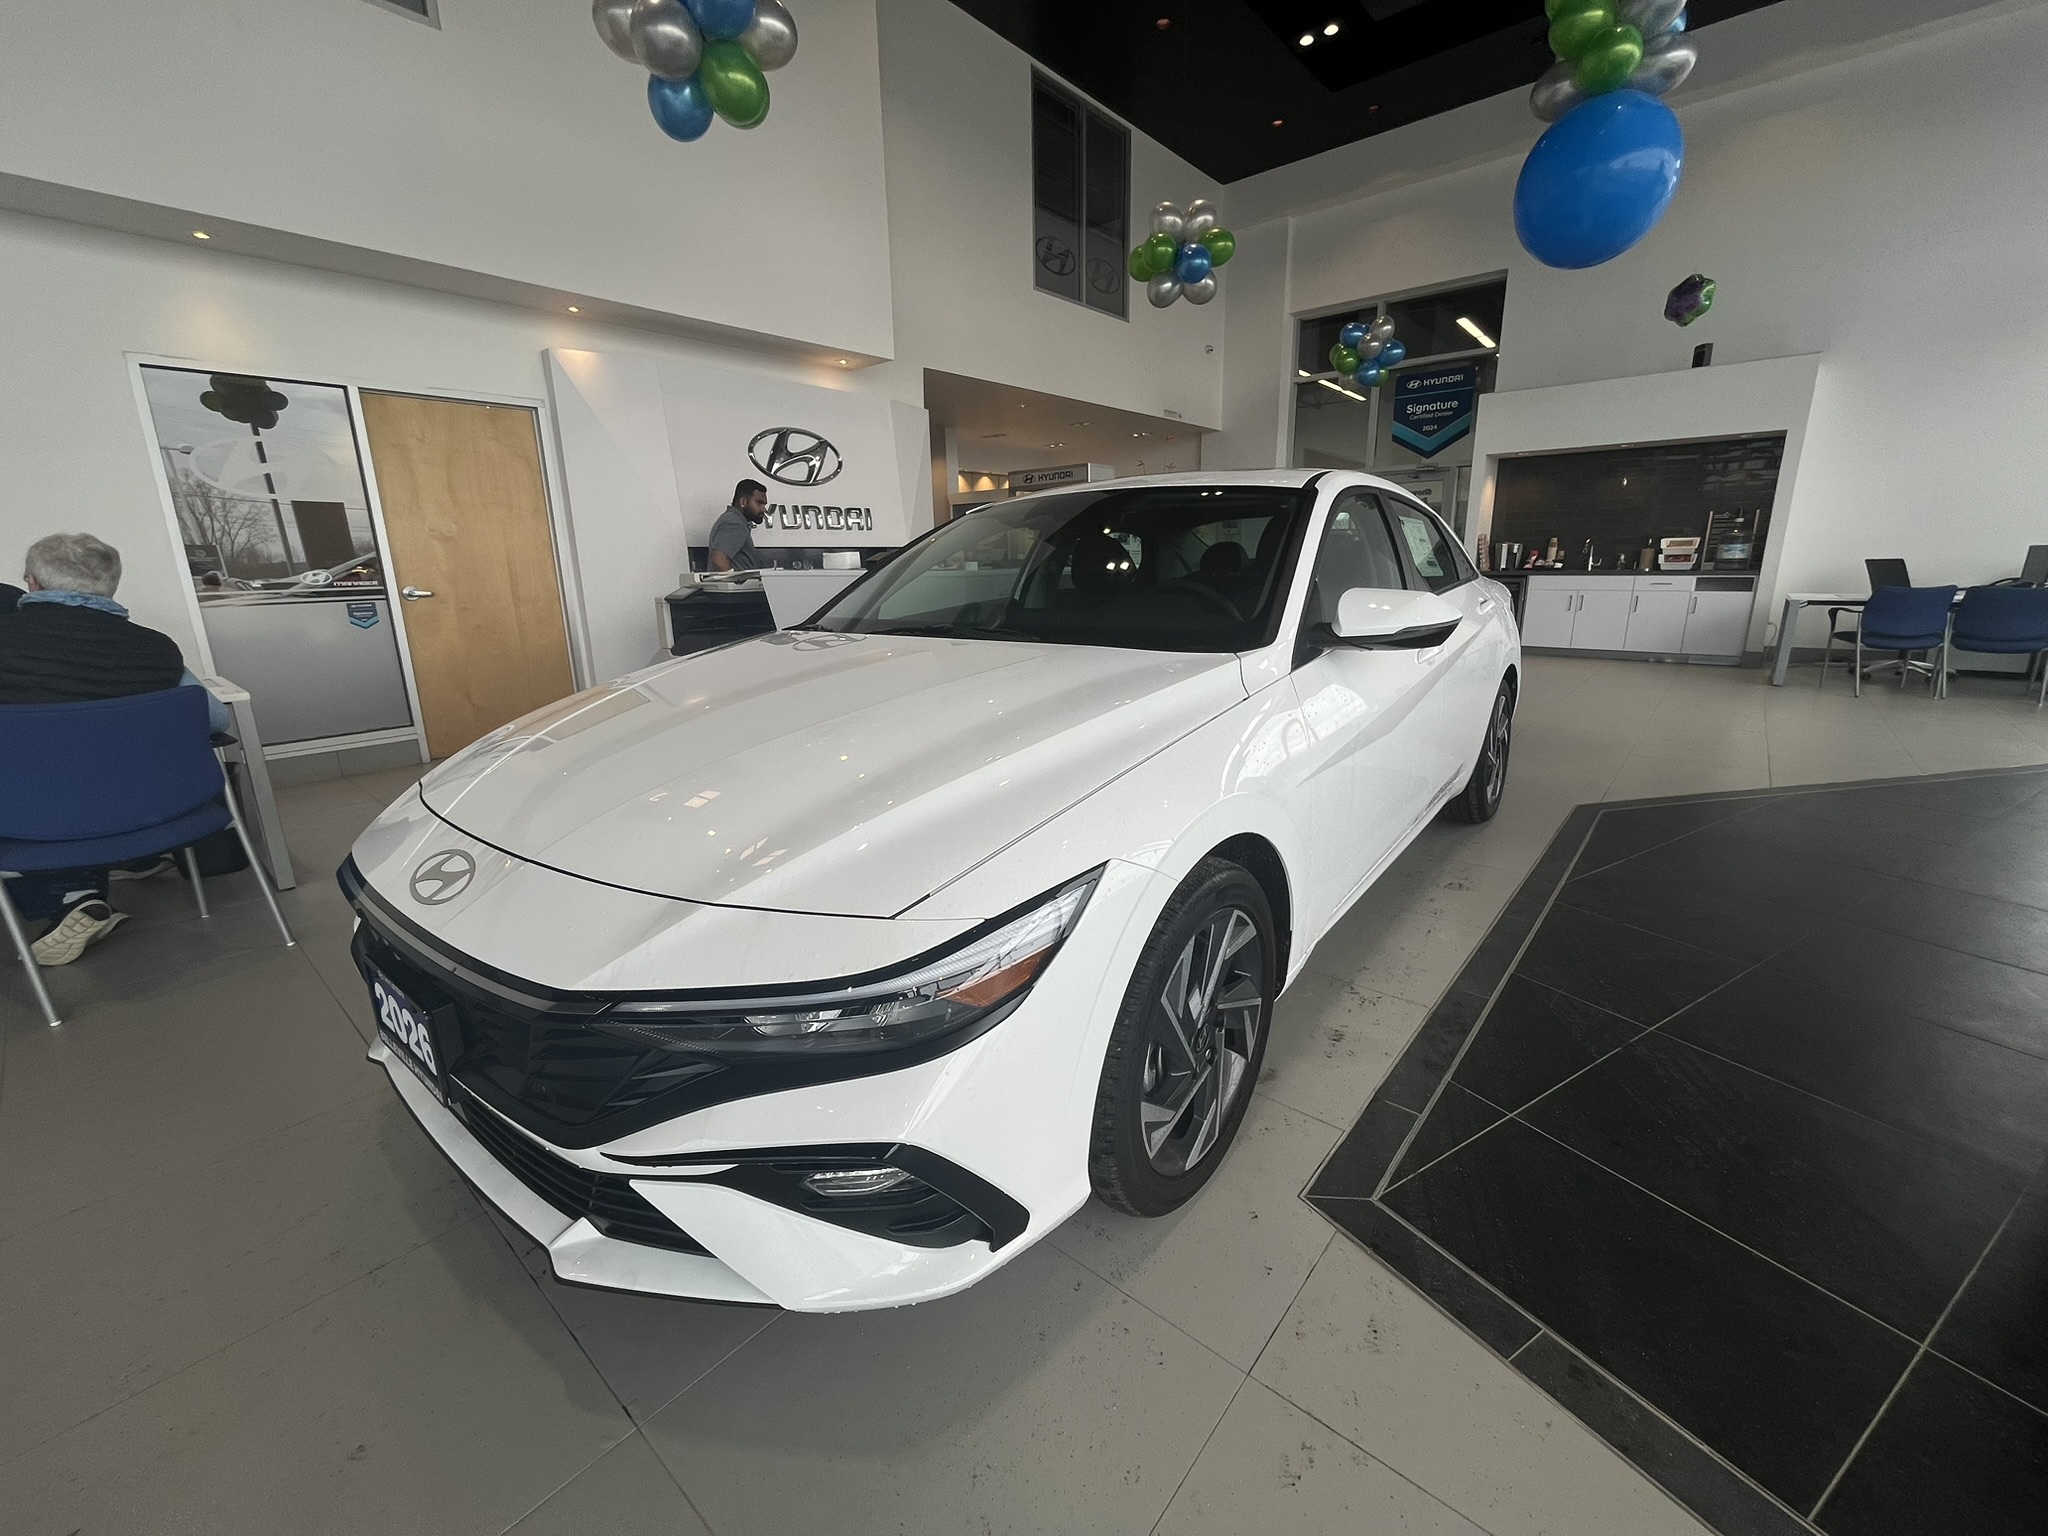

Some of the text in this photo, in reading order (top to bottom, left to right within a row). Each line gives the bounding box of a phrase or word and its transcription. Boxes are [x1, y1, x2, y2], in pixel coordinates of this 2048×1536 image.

[1423, 374, 1464, 386] HYUNDAI
[1406, 400, 1458, 414] Signature
[1409, 412, 1434, 421] Certified
[1422, 424, 1438, 432] 2024
[1038, 470, 1074, 482] HYUNDAI
[749, 503, 873, 531] YUNDAI
[374, 981, 438, 1077] 2026
